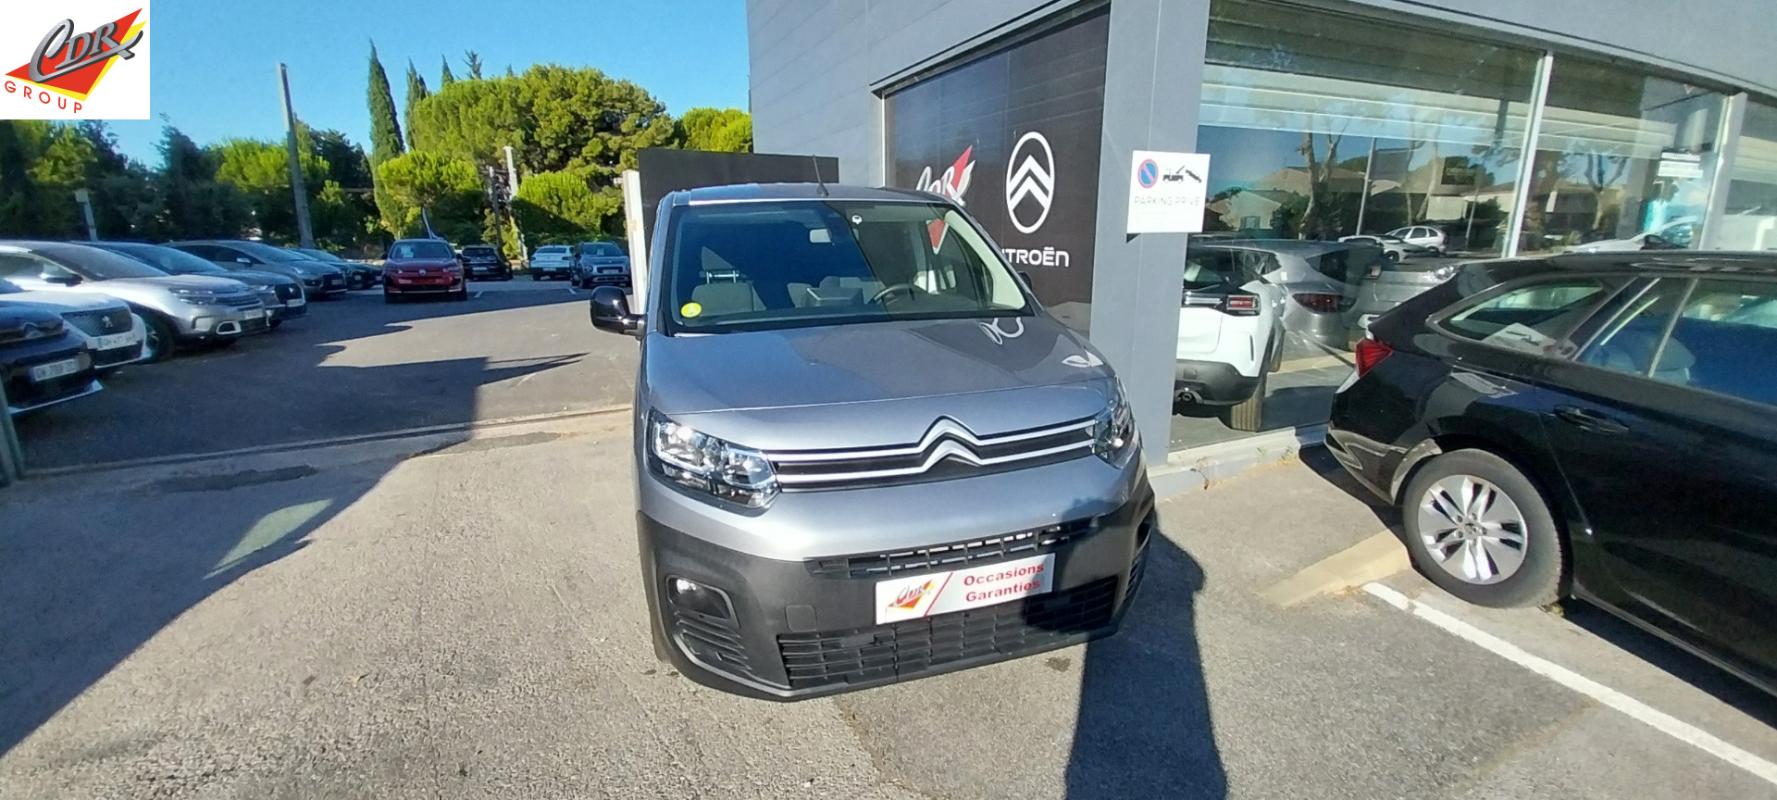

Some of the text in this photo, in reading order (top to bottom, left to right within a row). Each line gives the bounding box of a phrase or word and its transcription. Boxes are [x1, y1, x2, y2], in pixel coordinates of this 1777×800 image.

[1001, 246, 1070, 268] TROËN
[963, 563, 1045, 587] Occasions
[965, 580, 1042, 603] Garanties
